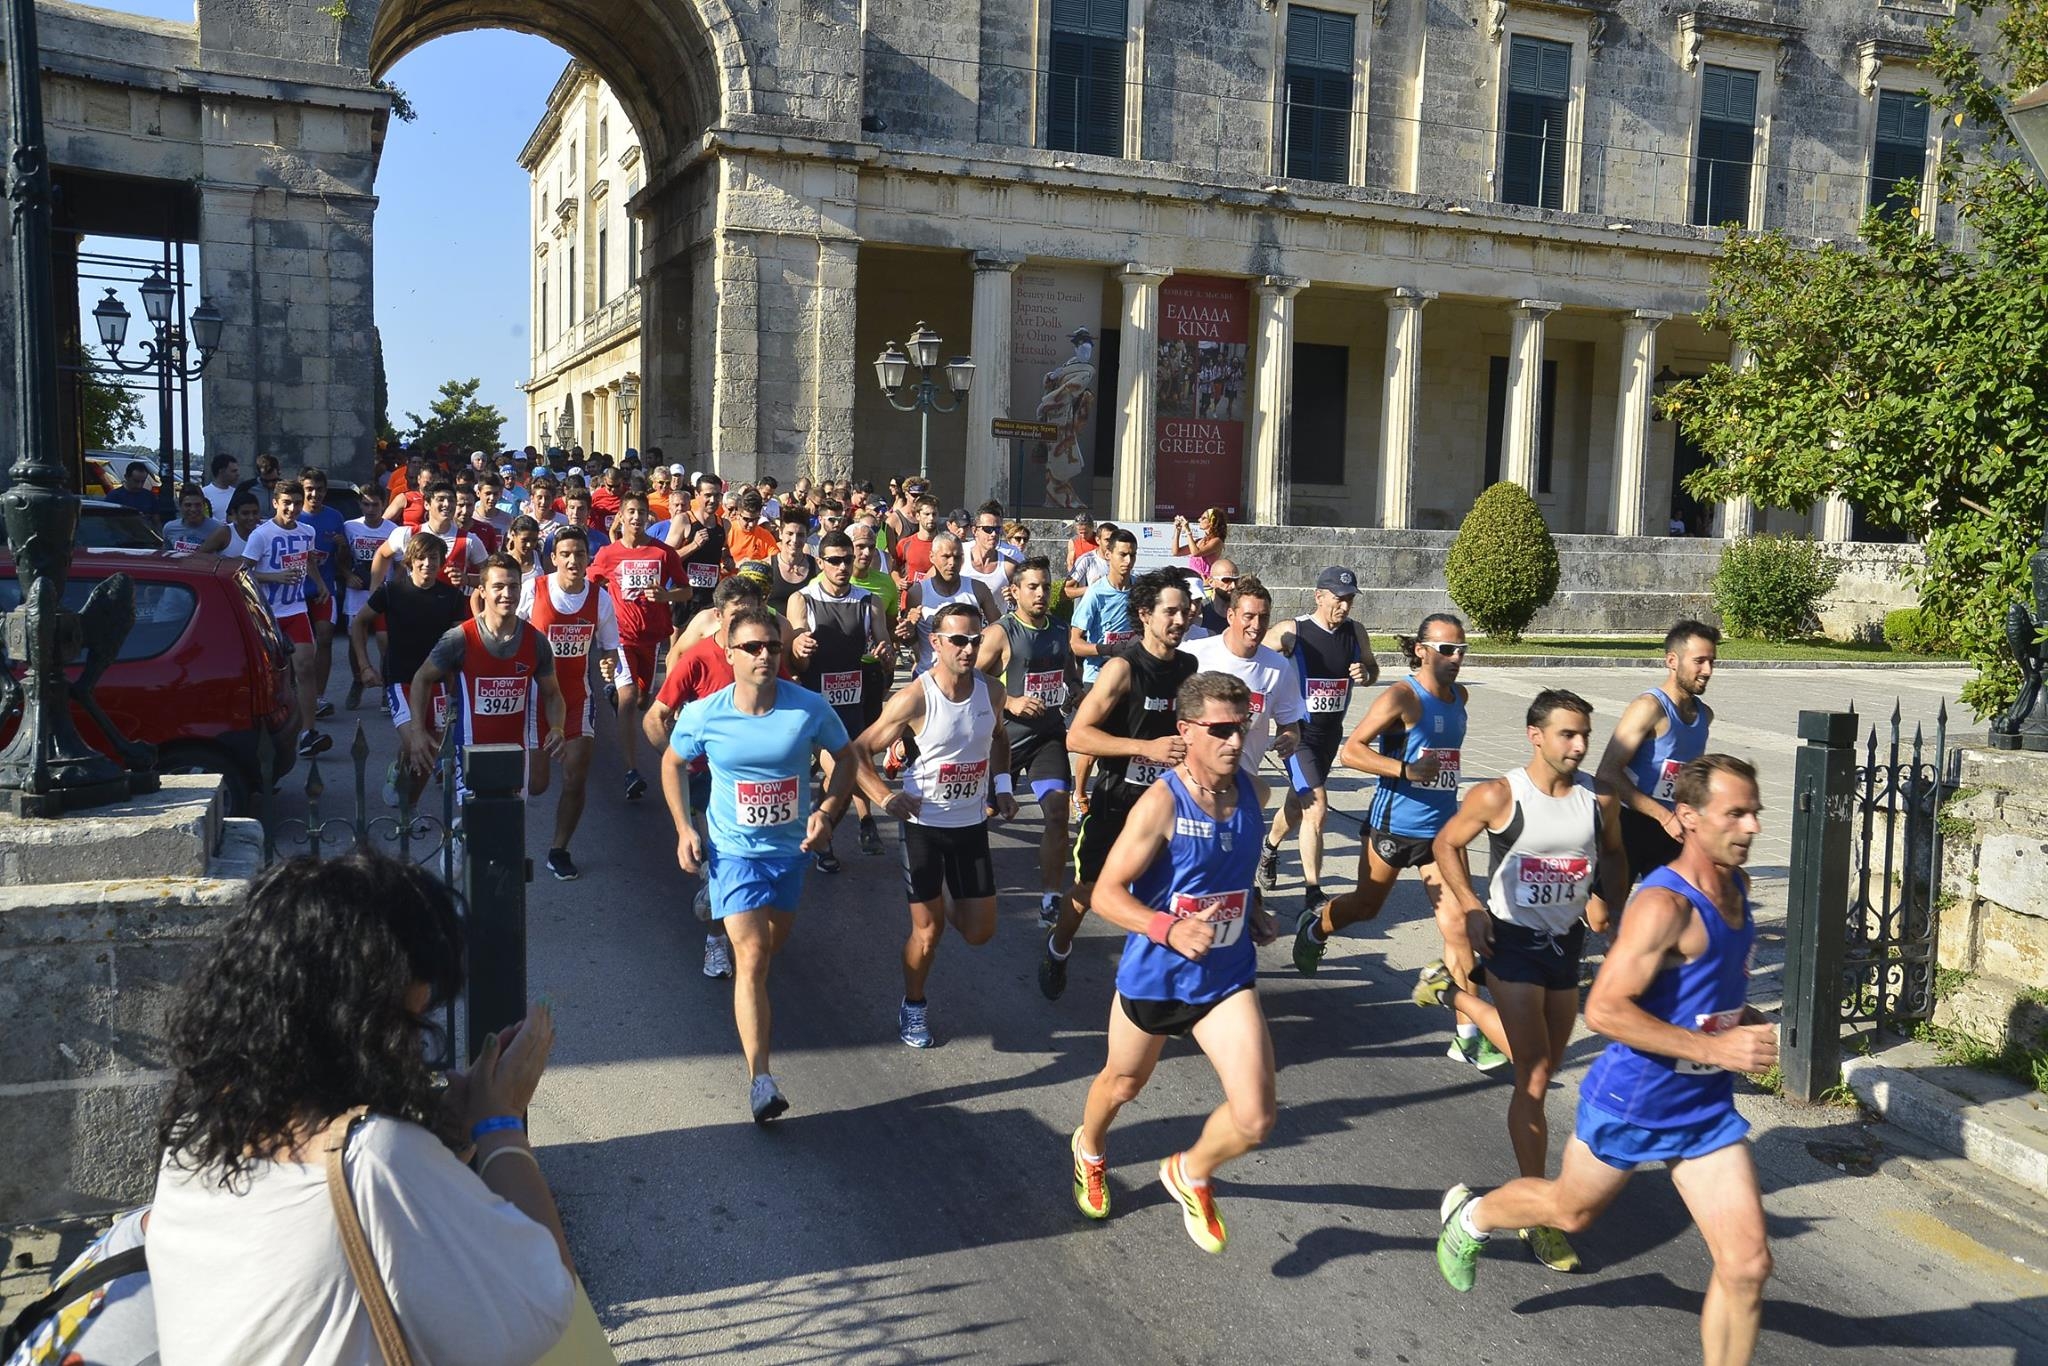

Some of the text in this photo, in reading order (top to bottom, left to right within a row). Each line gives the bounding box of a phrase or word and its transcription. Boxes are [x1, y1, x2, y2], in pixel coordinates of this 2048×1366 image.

[1015, 300, 1058, 315] Japanese
[1167, 304, 1231, 323] ΕΛΛΑΔΑ
[1015, 315, 1063, 329] Art Dolls
[1026, 329, 1057, 342] Ohno
[1177, 320, 1220, 338] ΚΙΝΑ
[1015, 343, 1057, 357] Hatsuko
[1165, 423, 1221, 439] CHINA
[1160, 438, 1226, 455] GREECE
[270, 535, 313, 570] GET
[360, 549, 375, 560] 387
[625, 567, 657, 575] balance
[692, 576, 712, 587] 3850
[552, 632, 591, 642] balance
[555, 642, 585, 655] 3864
[492, 679, 515, 688] new
[835, 673, 852, 681] new
[1040, 672, 1055, 682] new
[480, 685, 525, 697] balance
[826, 680, 860, 690] balance
[829, 689, 856, 704] 3907
[1309, 687, 1347, 697] balance
[484, 698, 518, 713] 3947
[1313, 697, 1341, 711] 3894
[954, 762, 978, 773] new
[755, 782, 783, 794] new
[943, 781, 979, 800] 3943
[741, 790, 795, 805] balance
[746, 802, 791, 824] 3955
[1540, 858, 1570, 871] new
[1528, 883, 1576, 904] 3814
